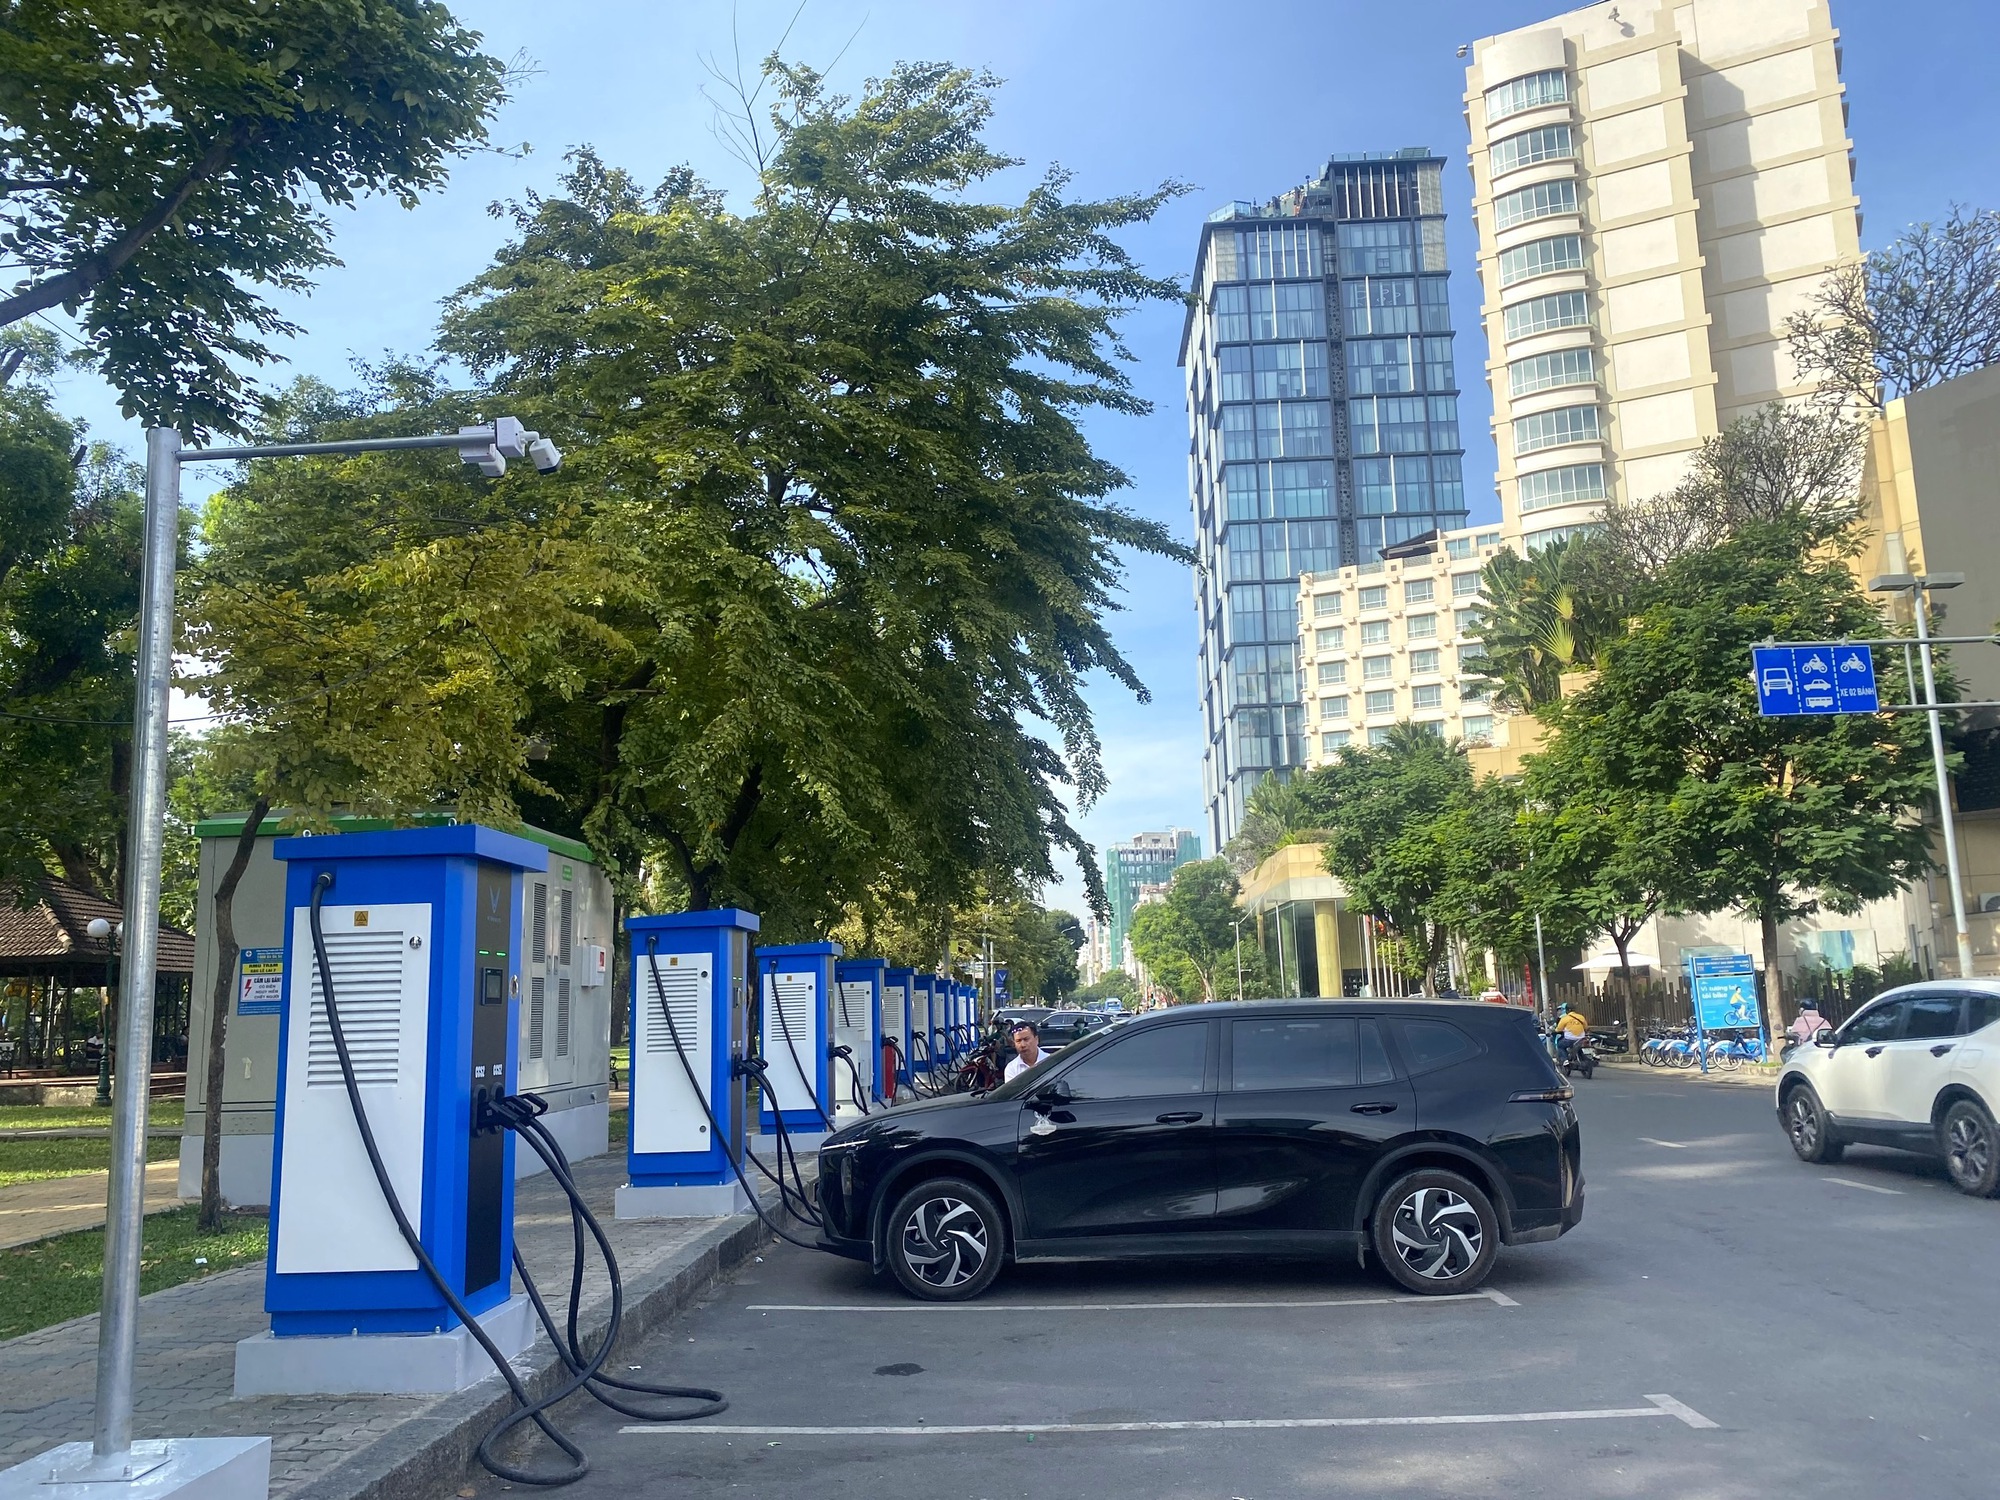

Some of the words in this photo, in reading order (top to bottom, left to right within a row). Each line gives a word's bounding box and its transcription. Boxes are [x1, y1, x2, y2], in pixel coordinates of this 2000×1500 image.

[1840, 688, 1849, 696] XE
[1849, 688, 1856, 696] 02
[1857, 685, 1875, 696] BÁNH
